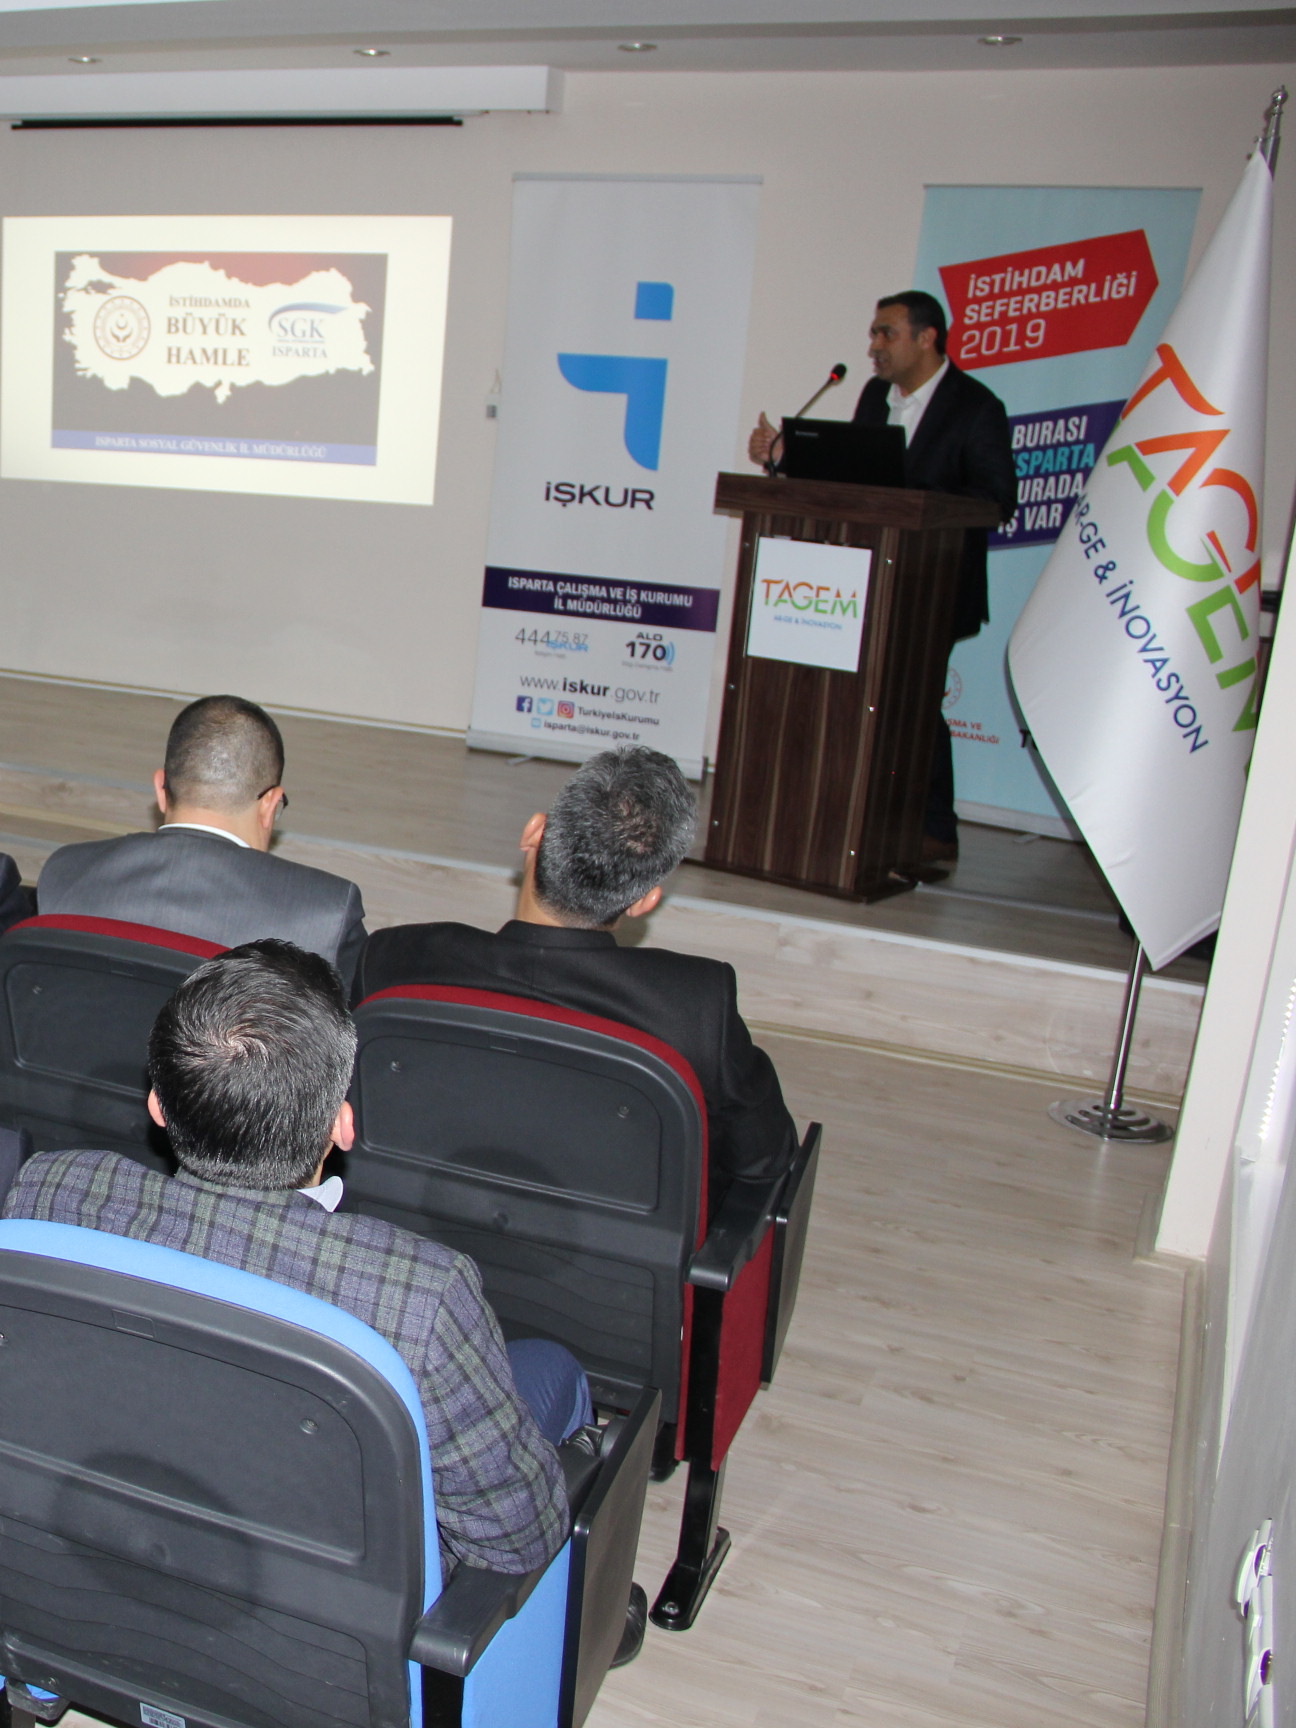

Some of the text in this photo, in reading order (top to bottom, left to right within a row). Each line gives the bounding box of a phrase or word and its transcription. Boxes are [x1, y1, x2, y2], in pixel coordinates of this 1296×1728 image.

[967, 258, 1085, 299] İSTİHDAM
[168, 295, 251, 309] İSTİHDAMDA
[963, 271, 1138, 325] SEFERBERLİĞİ
[166, 312, 247, 337] BÜYÜK
[277, 317, 325, 339] SGK
[960, 318, 1046, 360] 2019
[166, 346, 250, 367] HAMLE
[272, 345, 328, 359] ISPARTA
[1011, 415, 1088, 449] BURASI
[95, 435, 137, 448] ISPARTA
[138, 438, 178, 451] SOSYAL
[180, 438, 238, 454] GÜVENLİK
[1013, 443, 1095, 477] SPARTA
[1024, 503, 1063, 531] VAR
[1094, 561, 1117, 585] &
[508, 576, 554, 593] ISPARTA
[556, 581, 607, 600] ÇALIŞMA
[609, 586, 624, 600] VE
[640, 590, 694, 608] KURUMU
[761, 578, 858, 619] TAGEM
[566, 598, 642, 619] MÜDÜRLÜĞÜ
[515, 628, 551, 645] 444
[636, 632, 663, 642] ALO
[626, 641, 667, 661] 170
[520, 676, 661, 703] www.iskur.gov.tr
[543, 719, 640, 741] isparta@iskur.gov.tr
